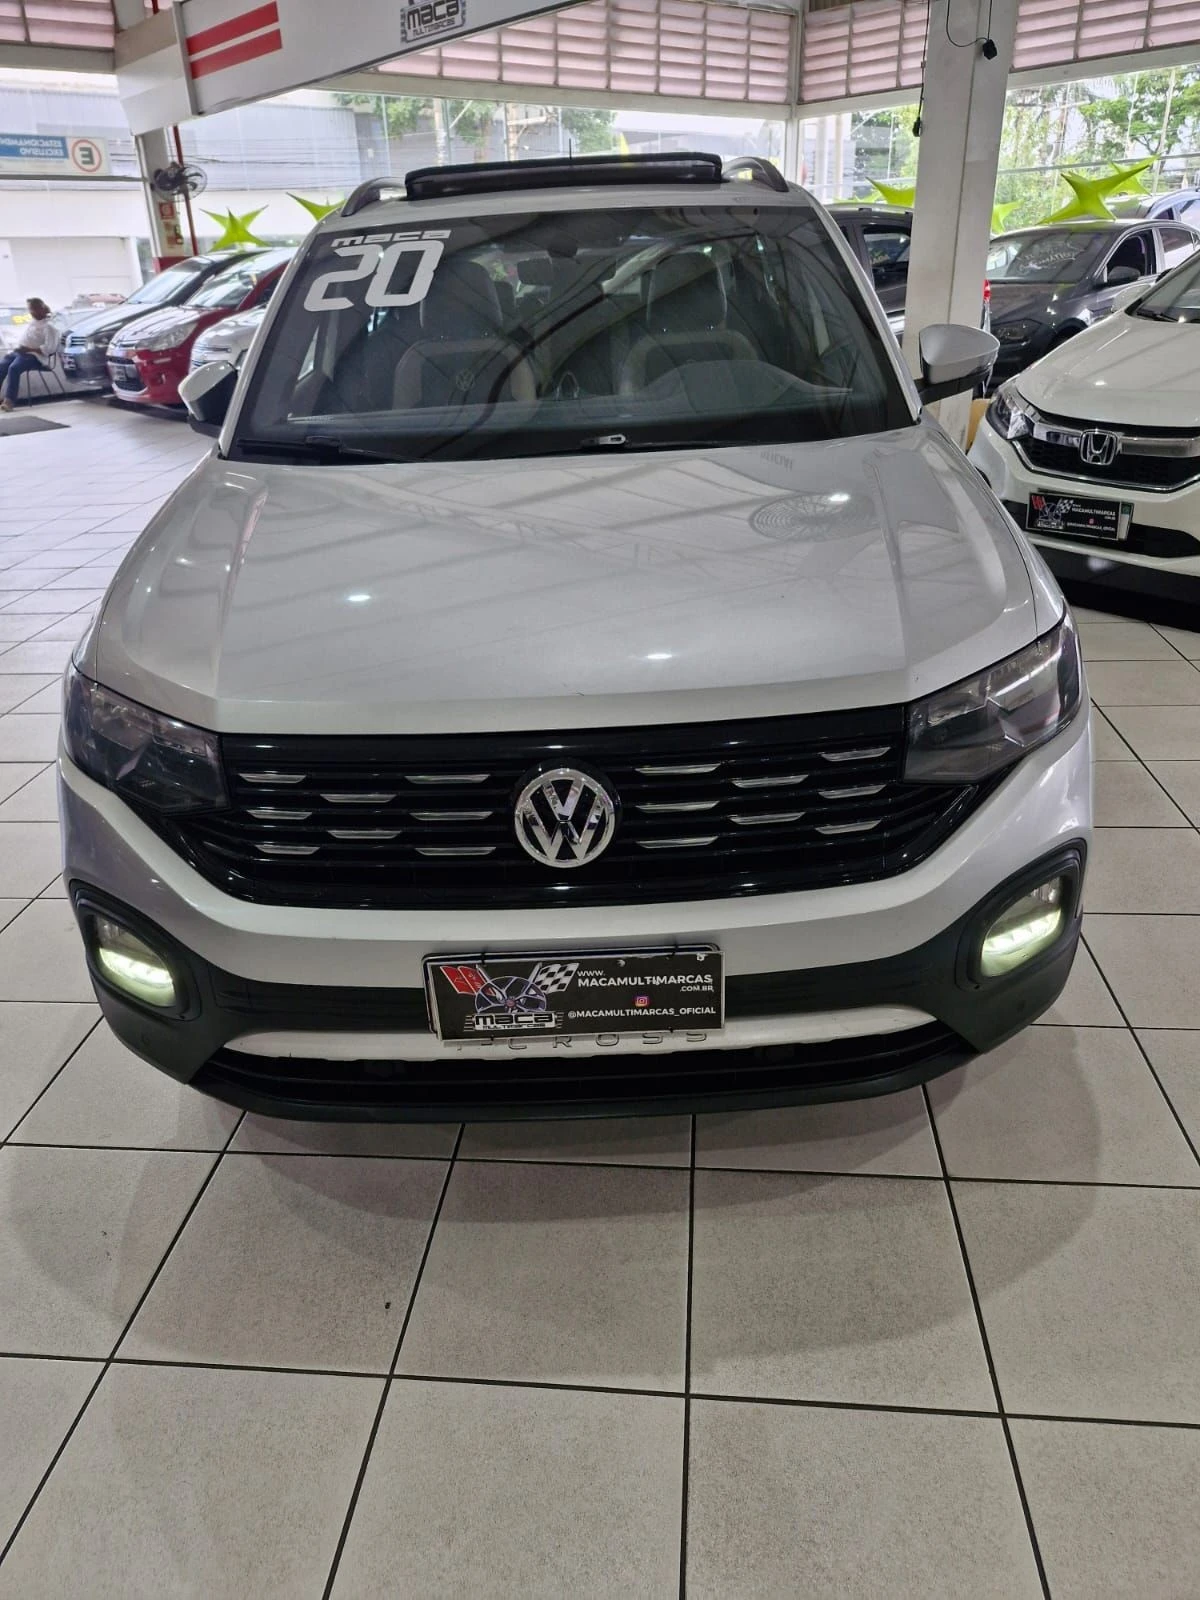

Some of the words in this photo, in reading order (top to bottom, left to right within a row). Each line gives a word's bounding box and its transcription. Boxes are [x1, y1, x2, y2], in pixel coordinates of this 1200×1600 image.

[303, 240, 445, 312] 20
[577, 974, 713, 988] MACAMULTIMARCAS
[567, 1006, 717, 1019] @MACAMULTIMARCAS_OFICIAL
